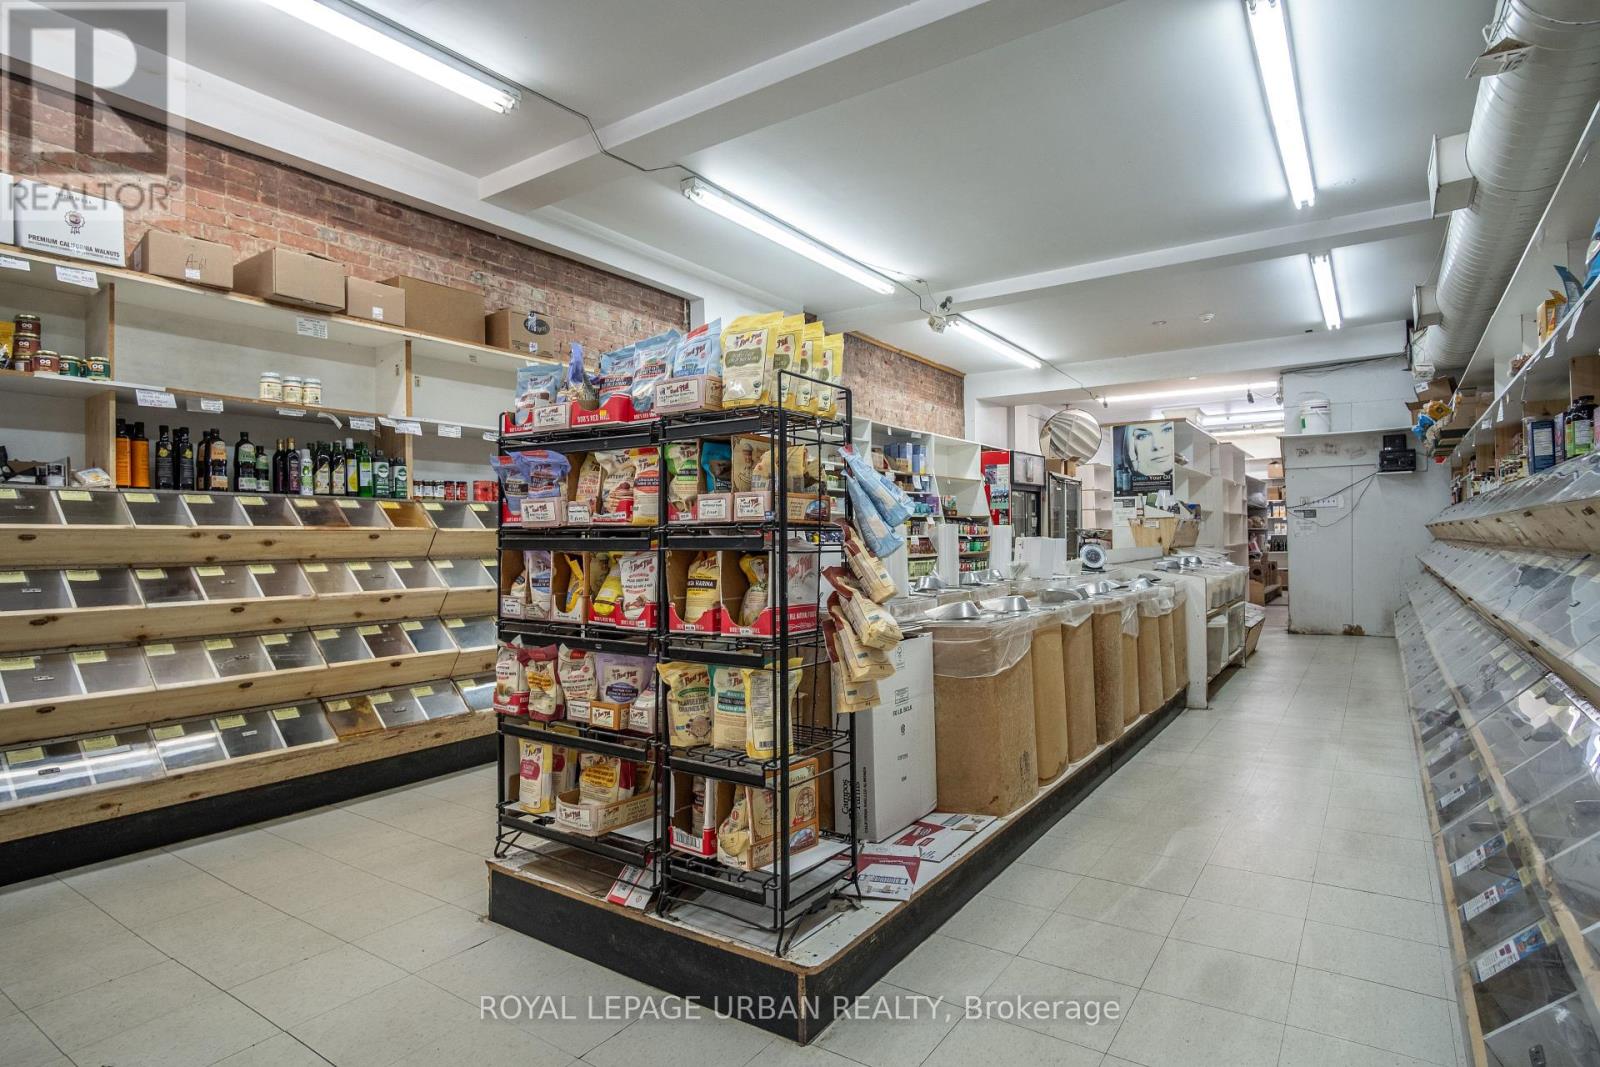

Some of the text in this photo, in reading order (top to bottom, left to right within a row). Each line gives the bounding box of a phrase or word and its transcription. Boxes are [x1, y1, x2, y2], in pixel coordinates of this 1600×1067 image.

[28, 234, 58, 245] PREMIUM
[94, 247, 120, 257] WALNUTS
[842, 777, 851, 814] Campos
